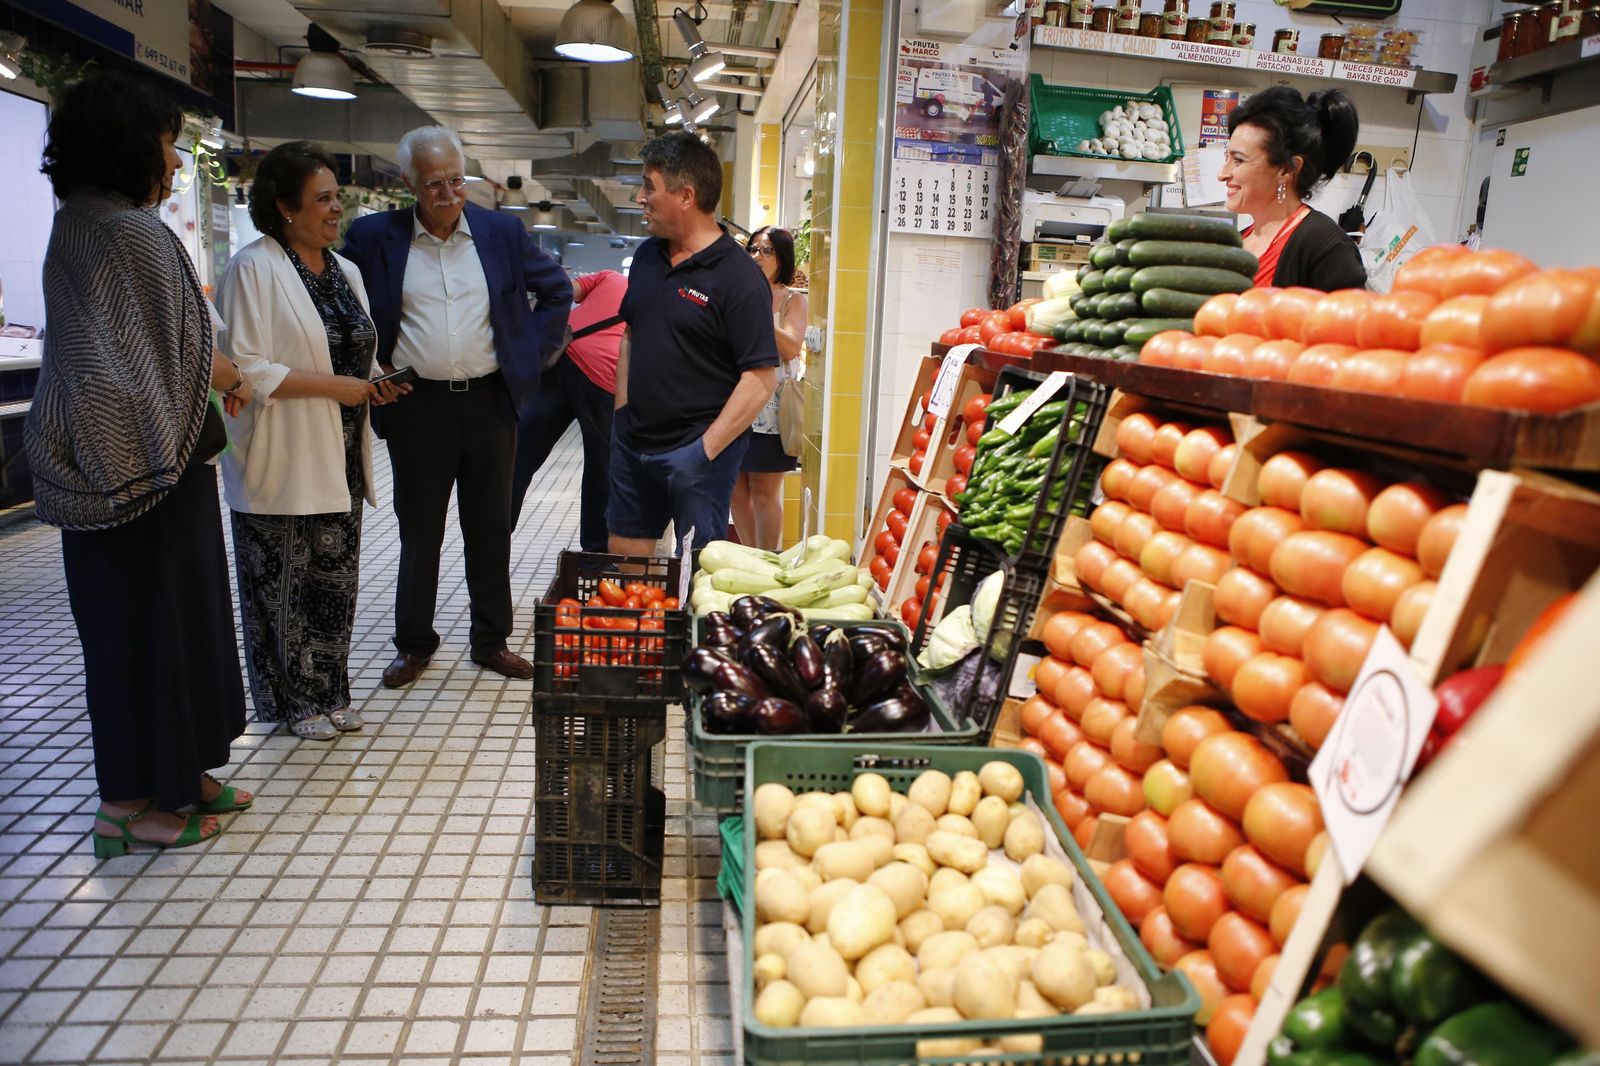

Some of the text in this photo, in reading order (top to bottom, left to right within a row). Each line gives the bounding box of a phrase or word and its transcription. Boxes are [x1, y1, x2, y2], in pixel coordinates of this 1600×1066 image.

[912, 41, 940, 49] FRUTAS
[1043, 28, 1074, 46] FRUTOS
[1079, 30, 1105, 49] SECOS
[1123, 36, 1157, 55] CALIDAD
[912, 47, 940, 56] MARCO
[1171, 42, 1241, 58] DATILES NATURALES
[144, 46, 188, 76] 649 52 67 49
[1177, 51, 1232, 65] ALMENDRUCO
[1257, 53, 1303, 65] AVELLANAS
[1256, 61, 1291, 72] PISTACHO
[1296, 66, 1324, 76] NUECES
[1342, 63, 1409, 78] NUECES PELADAS
[1346, 71, 1402, 85] BAYAS DE GOJI
[952, 168, 989, 181] 1 2 3
[901, 178, 990, 194] 5 6 7 8 9 10
[900, 190, 988, 208] 12 13 14 15 16 17
[898, 204, 988, 220] 19 20 21 22 23 24
[898, 217, 972, 232] 26 27 28 29 30
[688, 289, 708, 302] FRUTAS
